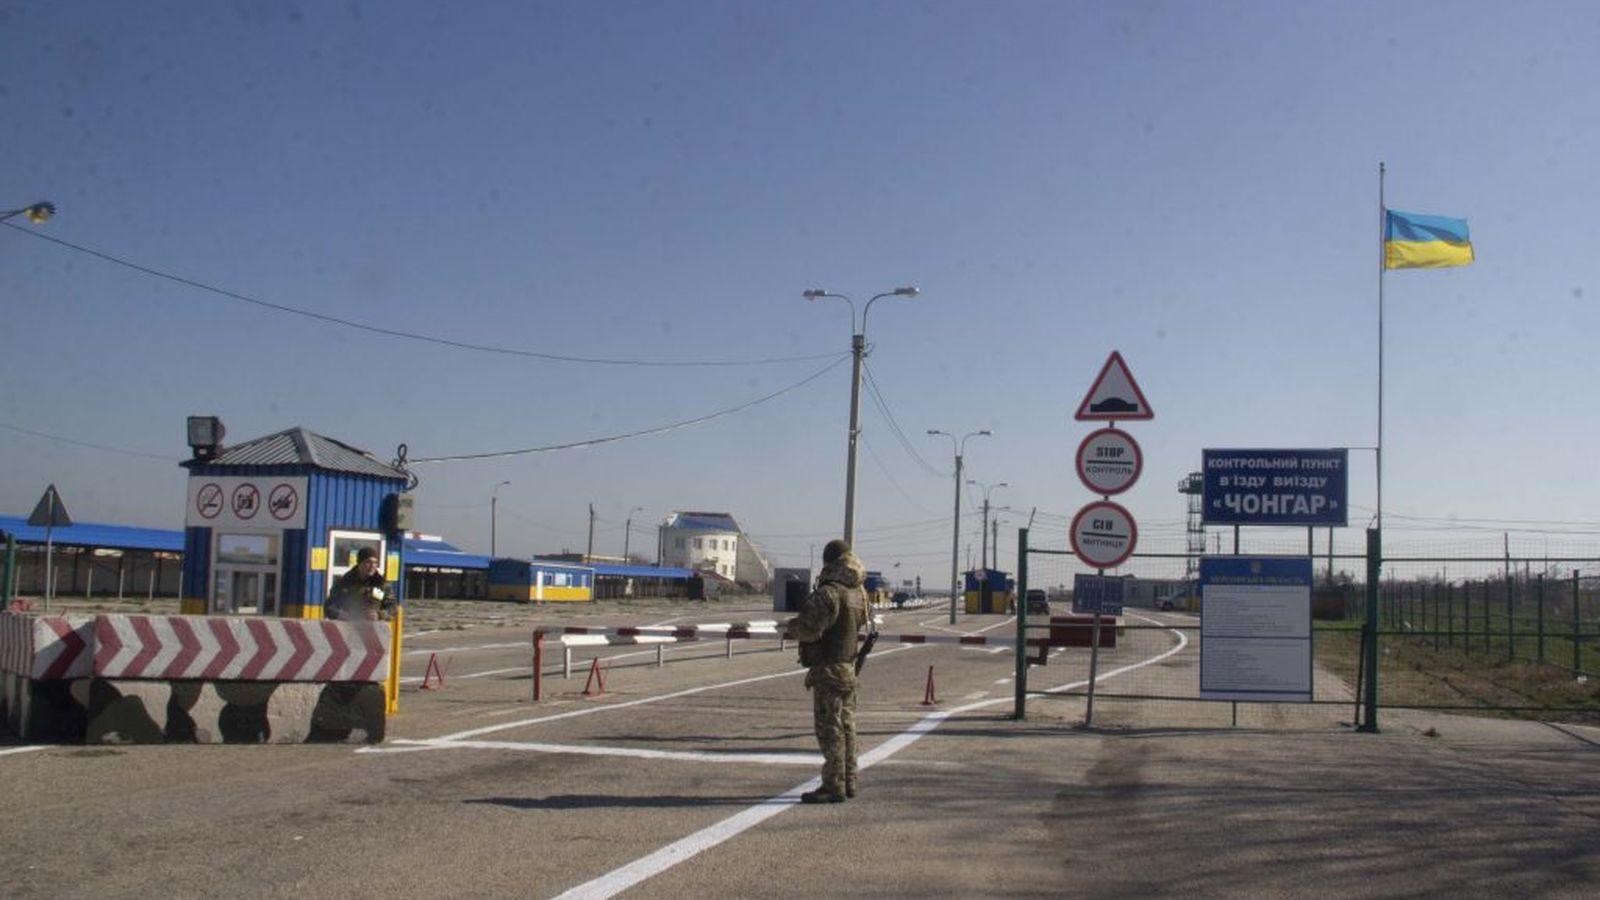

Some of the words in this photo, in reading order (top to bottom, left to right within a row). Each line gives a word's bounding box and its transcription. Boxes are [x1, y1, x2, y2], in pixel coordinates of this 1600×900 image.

[1096, 447, 1124, 458] STOP
[1208, 457, 1298, 469] КОНТРОЛЬНИЙ
[1301, 458, 1341, 469] ПУНКТ
[1086, 465, 1132, 475] КОНТРОЛЬ
